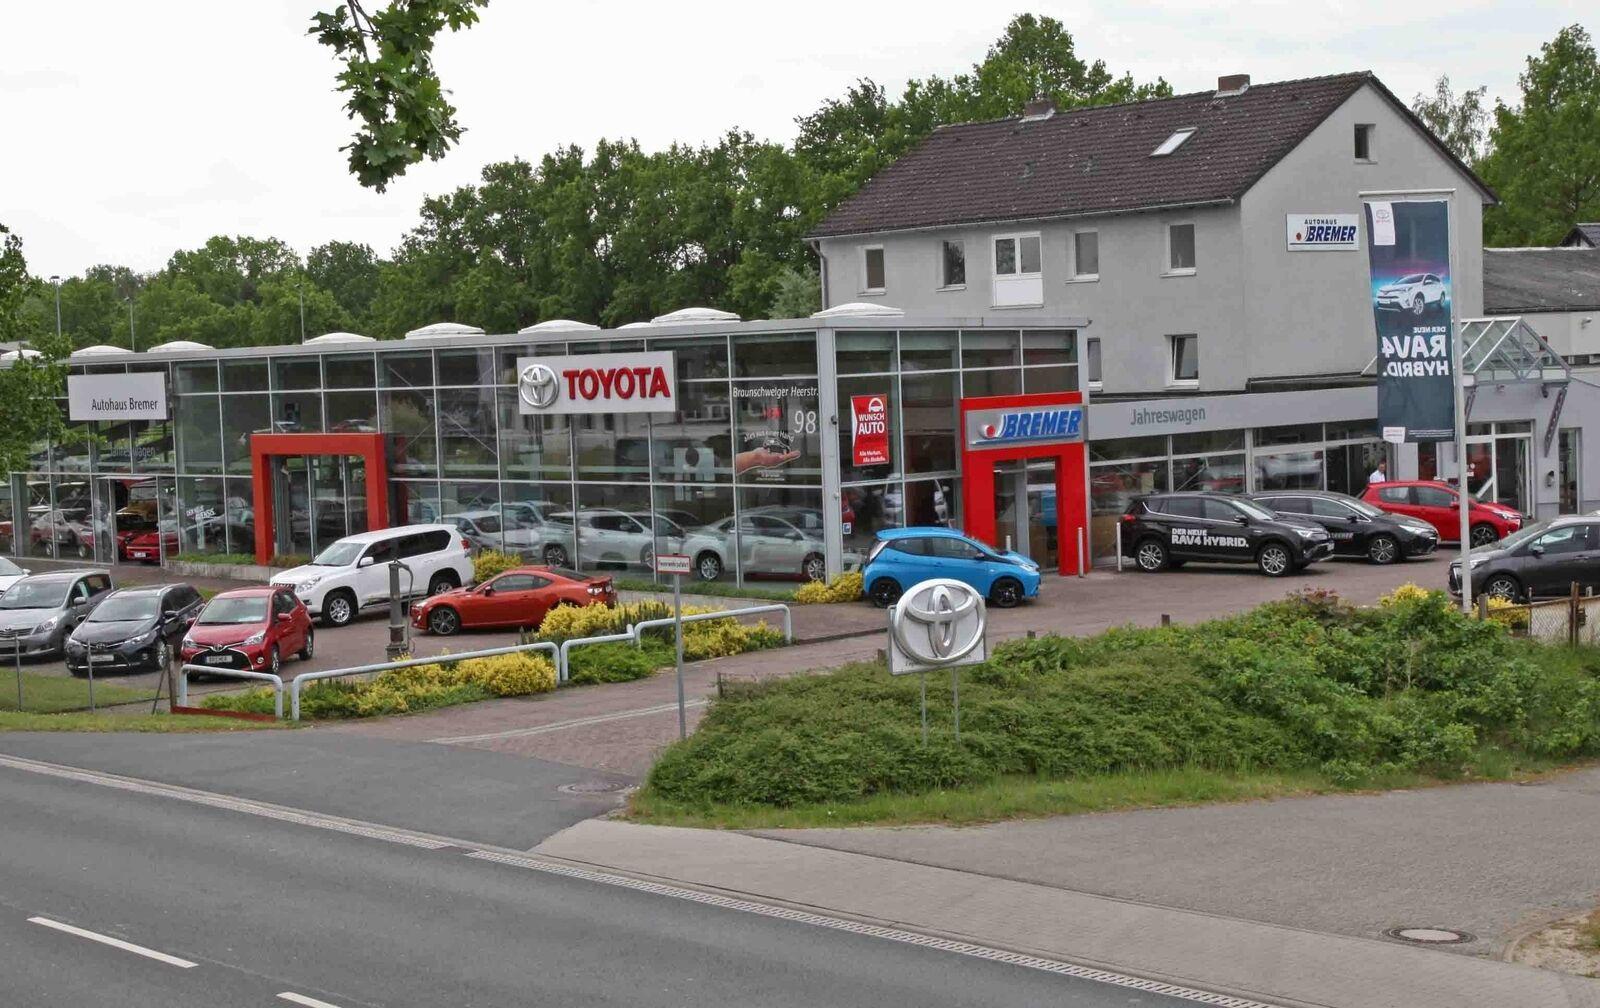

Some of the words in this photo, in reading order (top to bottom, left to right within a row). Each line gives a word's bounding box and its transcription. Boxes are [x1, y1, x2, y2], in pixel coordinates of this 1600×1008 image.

[1305, 226, 1357, 242] BREMER
[562, 366, 671, 400] TOYOTA
[732, 387, 789, 399] Braunschweiger
[790, 386, 819, 397] Heerstr.
[91, 398, 128, 411] Autohaus
[129, 397, 158, 410] Bremer
[794, 410, 817, 434] 98
[858, 412, 885, 421] WUNSCH
[1002, 410, 1083, 437] BREMER
[1130, 407, 1206, 426] Jahreswagen
[858, 421, 885, 435] AUTO
[1187, 528, 1208, 536] NEUE
[1171, 534, 1202, 546] RAV4
[1203, 536, 1250, 548] HYBRID.
